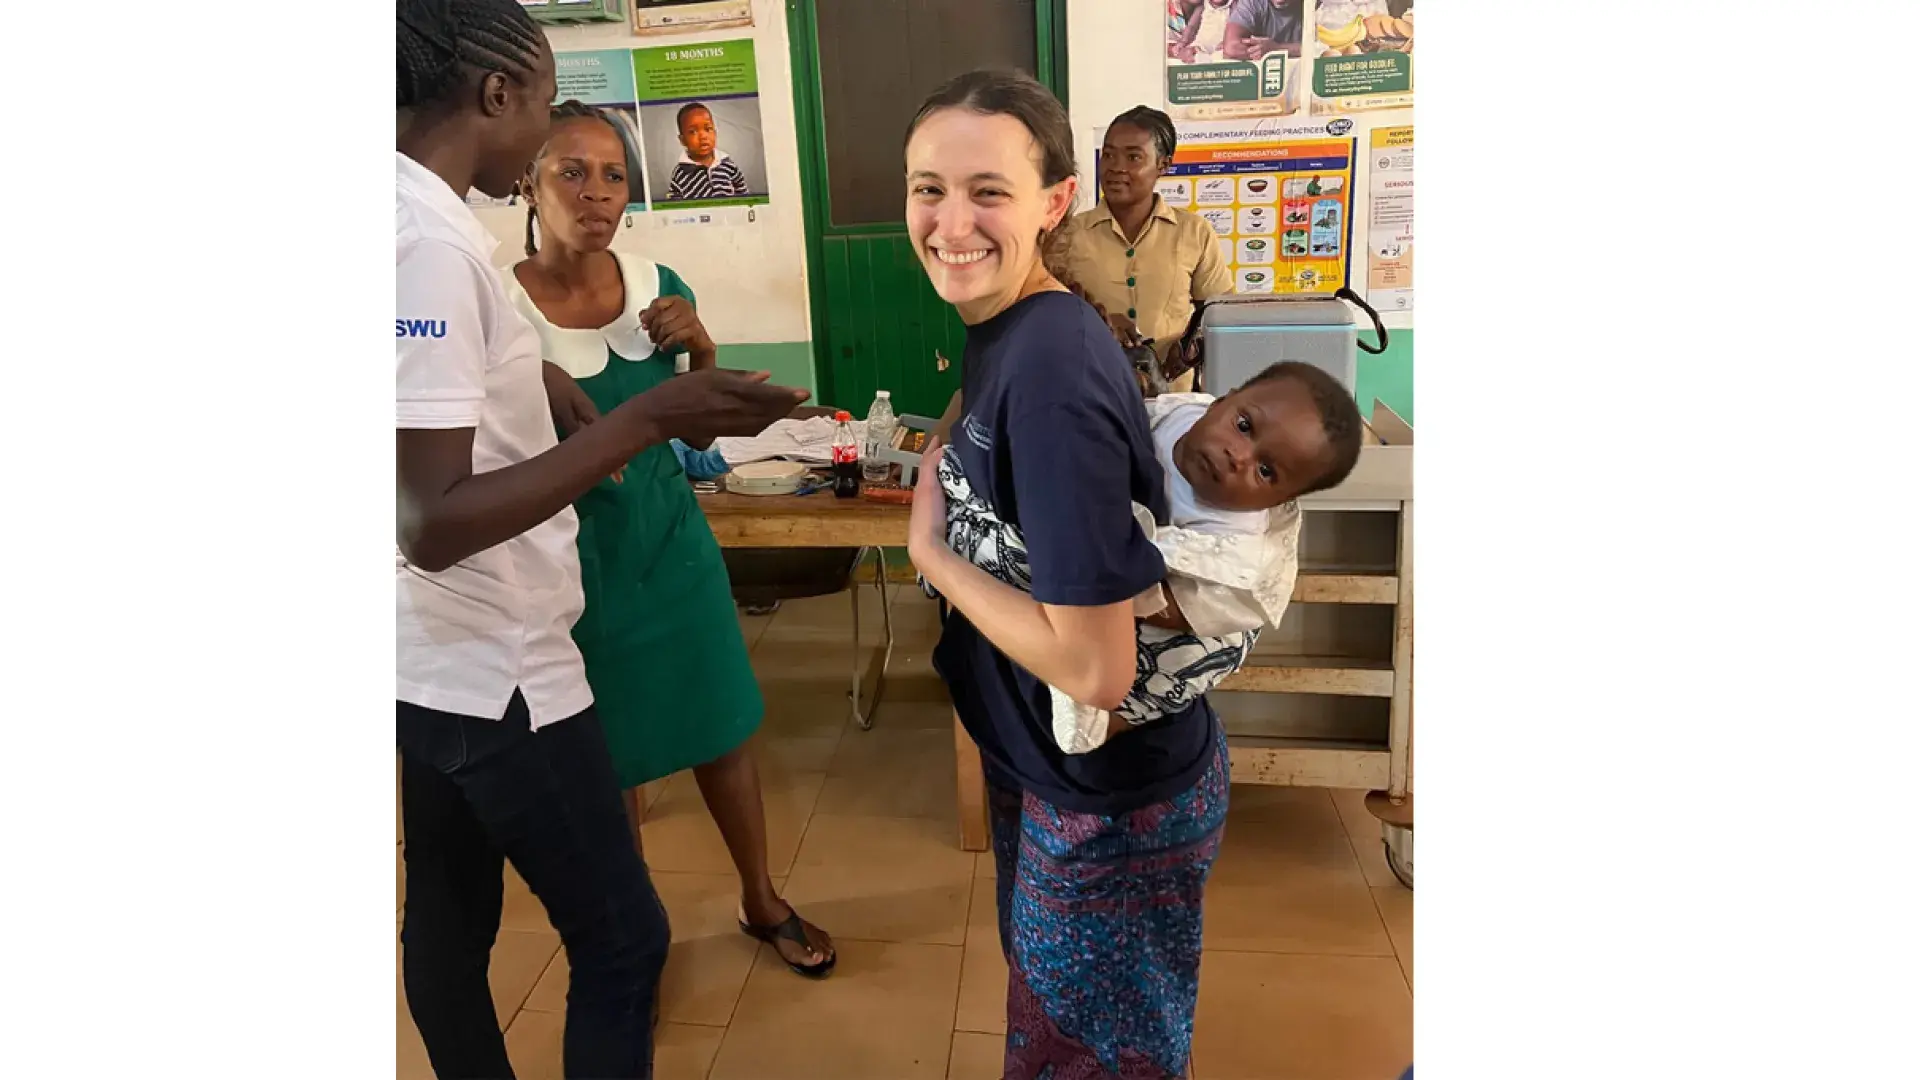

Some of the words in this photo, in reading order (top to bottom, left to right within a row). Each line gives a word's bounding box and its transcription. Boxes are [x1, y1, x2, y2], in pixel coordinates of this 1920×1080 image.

[664, 51, 678, 61] 18
[680, 47, 723, 60] MONTHS
[1356, 61, 1368, 70] FOR
[1177, 72, 1189, 80] PLAN
[1183, 131, 1248, 139] COMPLEMENTARY
[1249, 128, 1281, 137] FEEDING
[1283, 126, 1325, 135] PRACTICES
[1212, 148, 1289, 159] RECOMMENDATIONS
[396, 319, 446, 338] SWU
